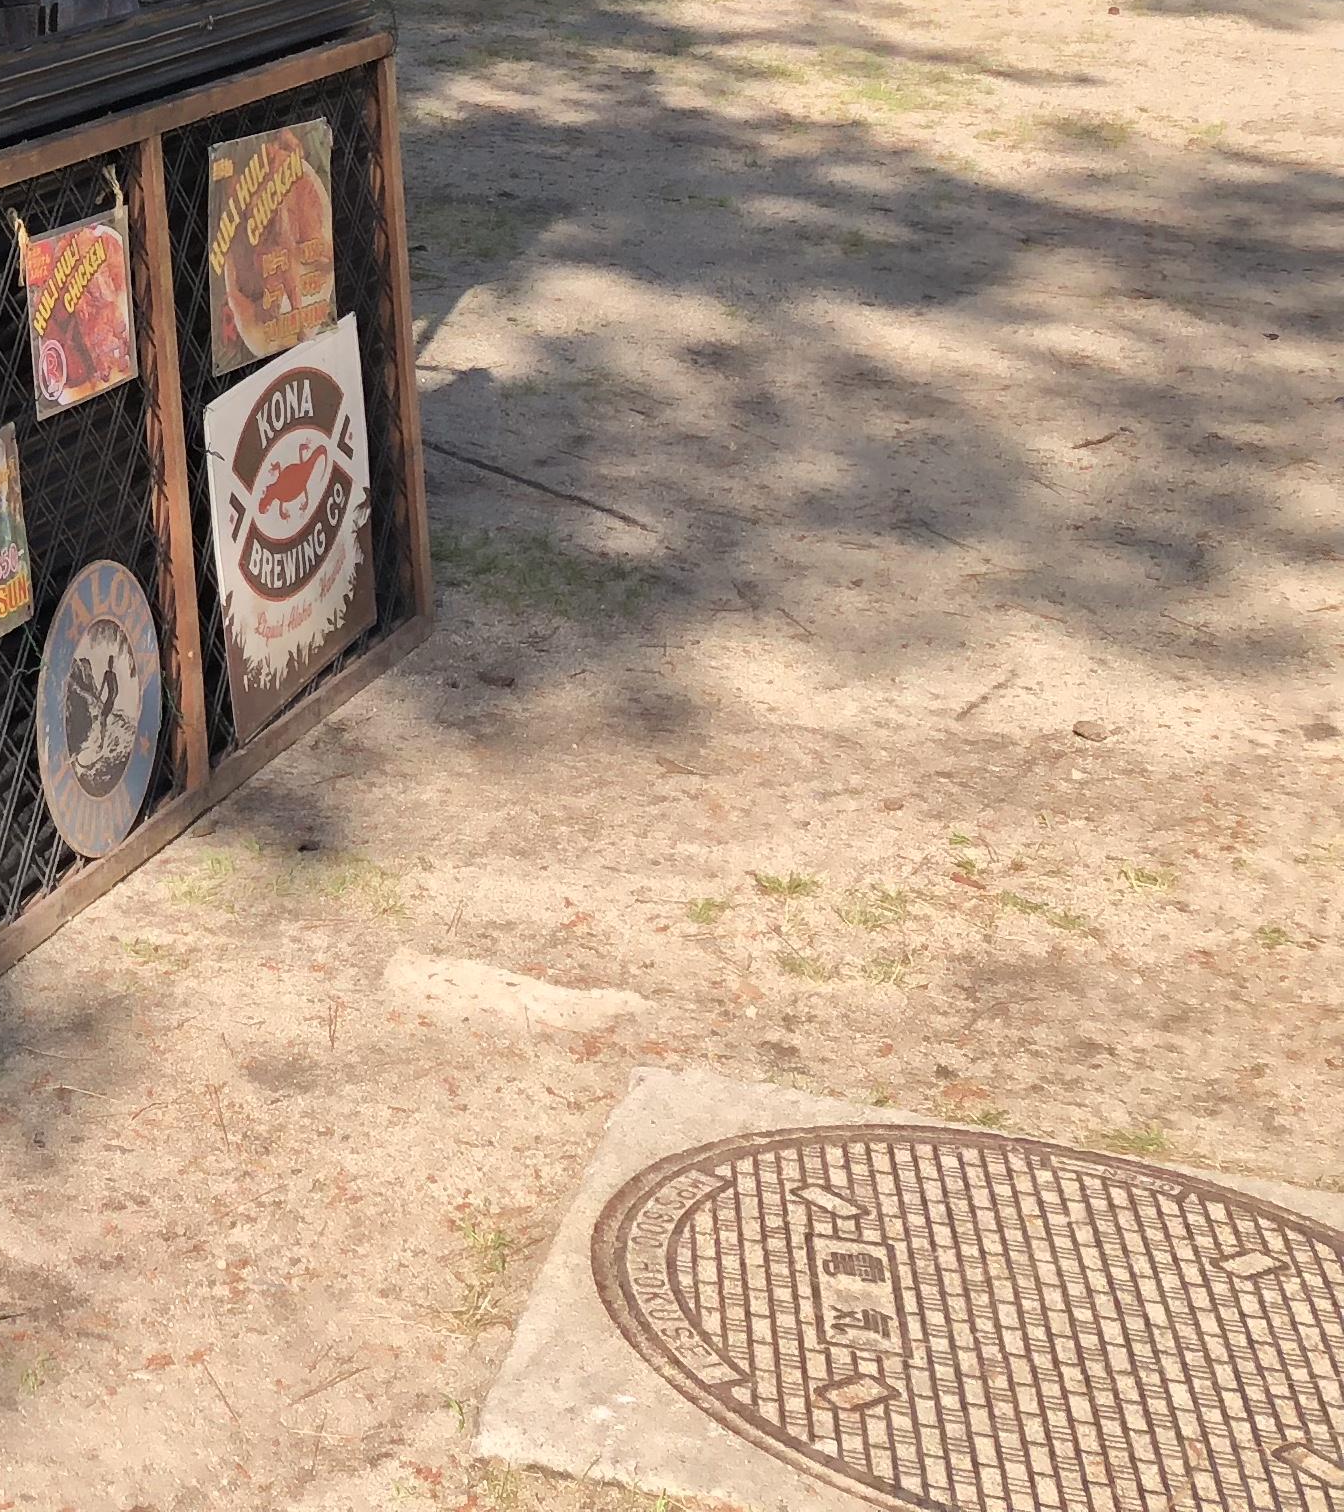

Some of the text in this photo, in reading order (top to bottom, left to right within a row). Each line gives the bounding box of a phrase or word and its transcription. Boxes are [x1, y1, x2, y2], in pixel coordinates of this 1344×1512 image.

[211, 197, 241, 276] HULI
[236, 143, 270, 209] HULI
[247, 148, 304, 246] CHICKEN
[33, 279, 60, 336] HULI
[54, 237, 80, 288] HULI
[64, 238, 107, 314] CHICKEN
[255, 378, 314, 449] KONA
[249, 523, 327, 589] BREWING
[822, 1251, 894, 1339] 電気
